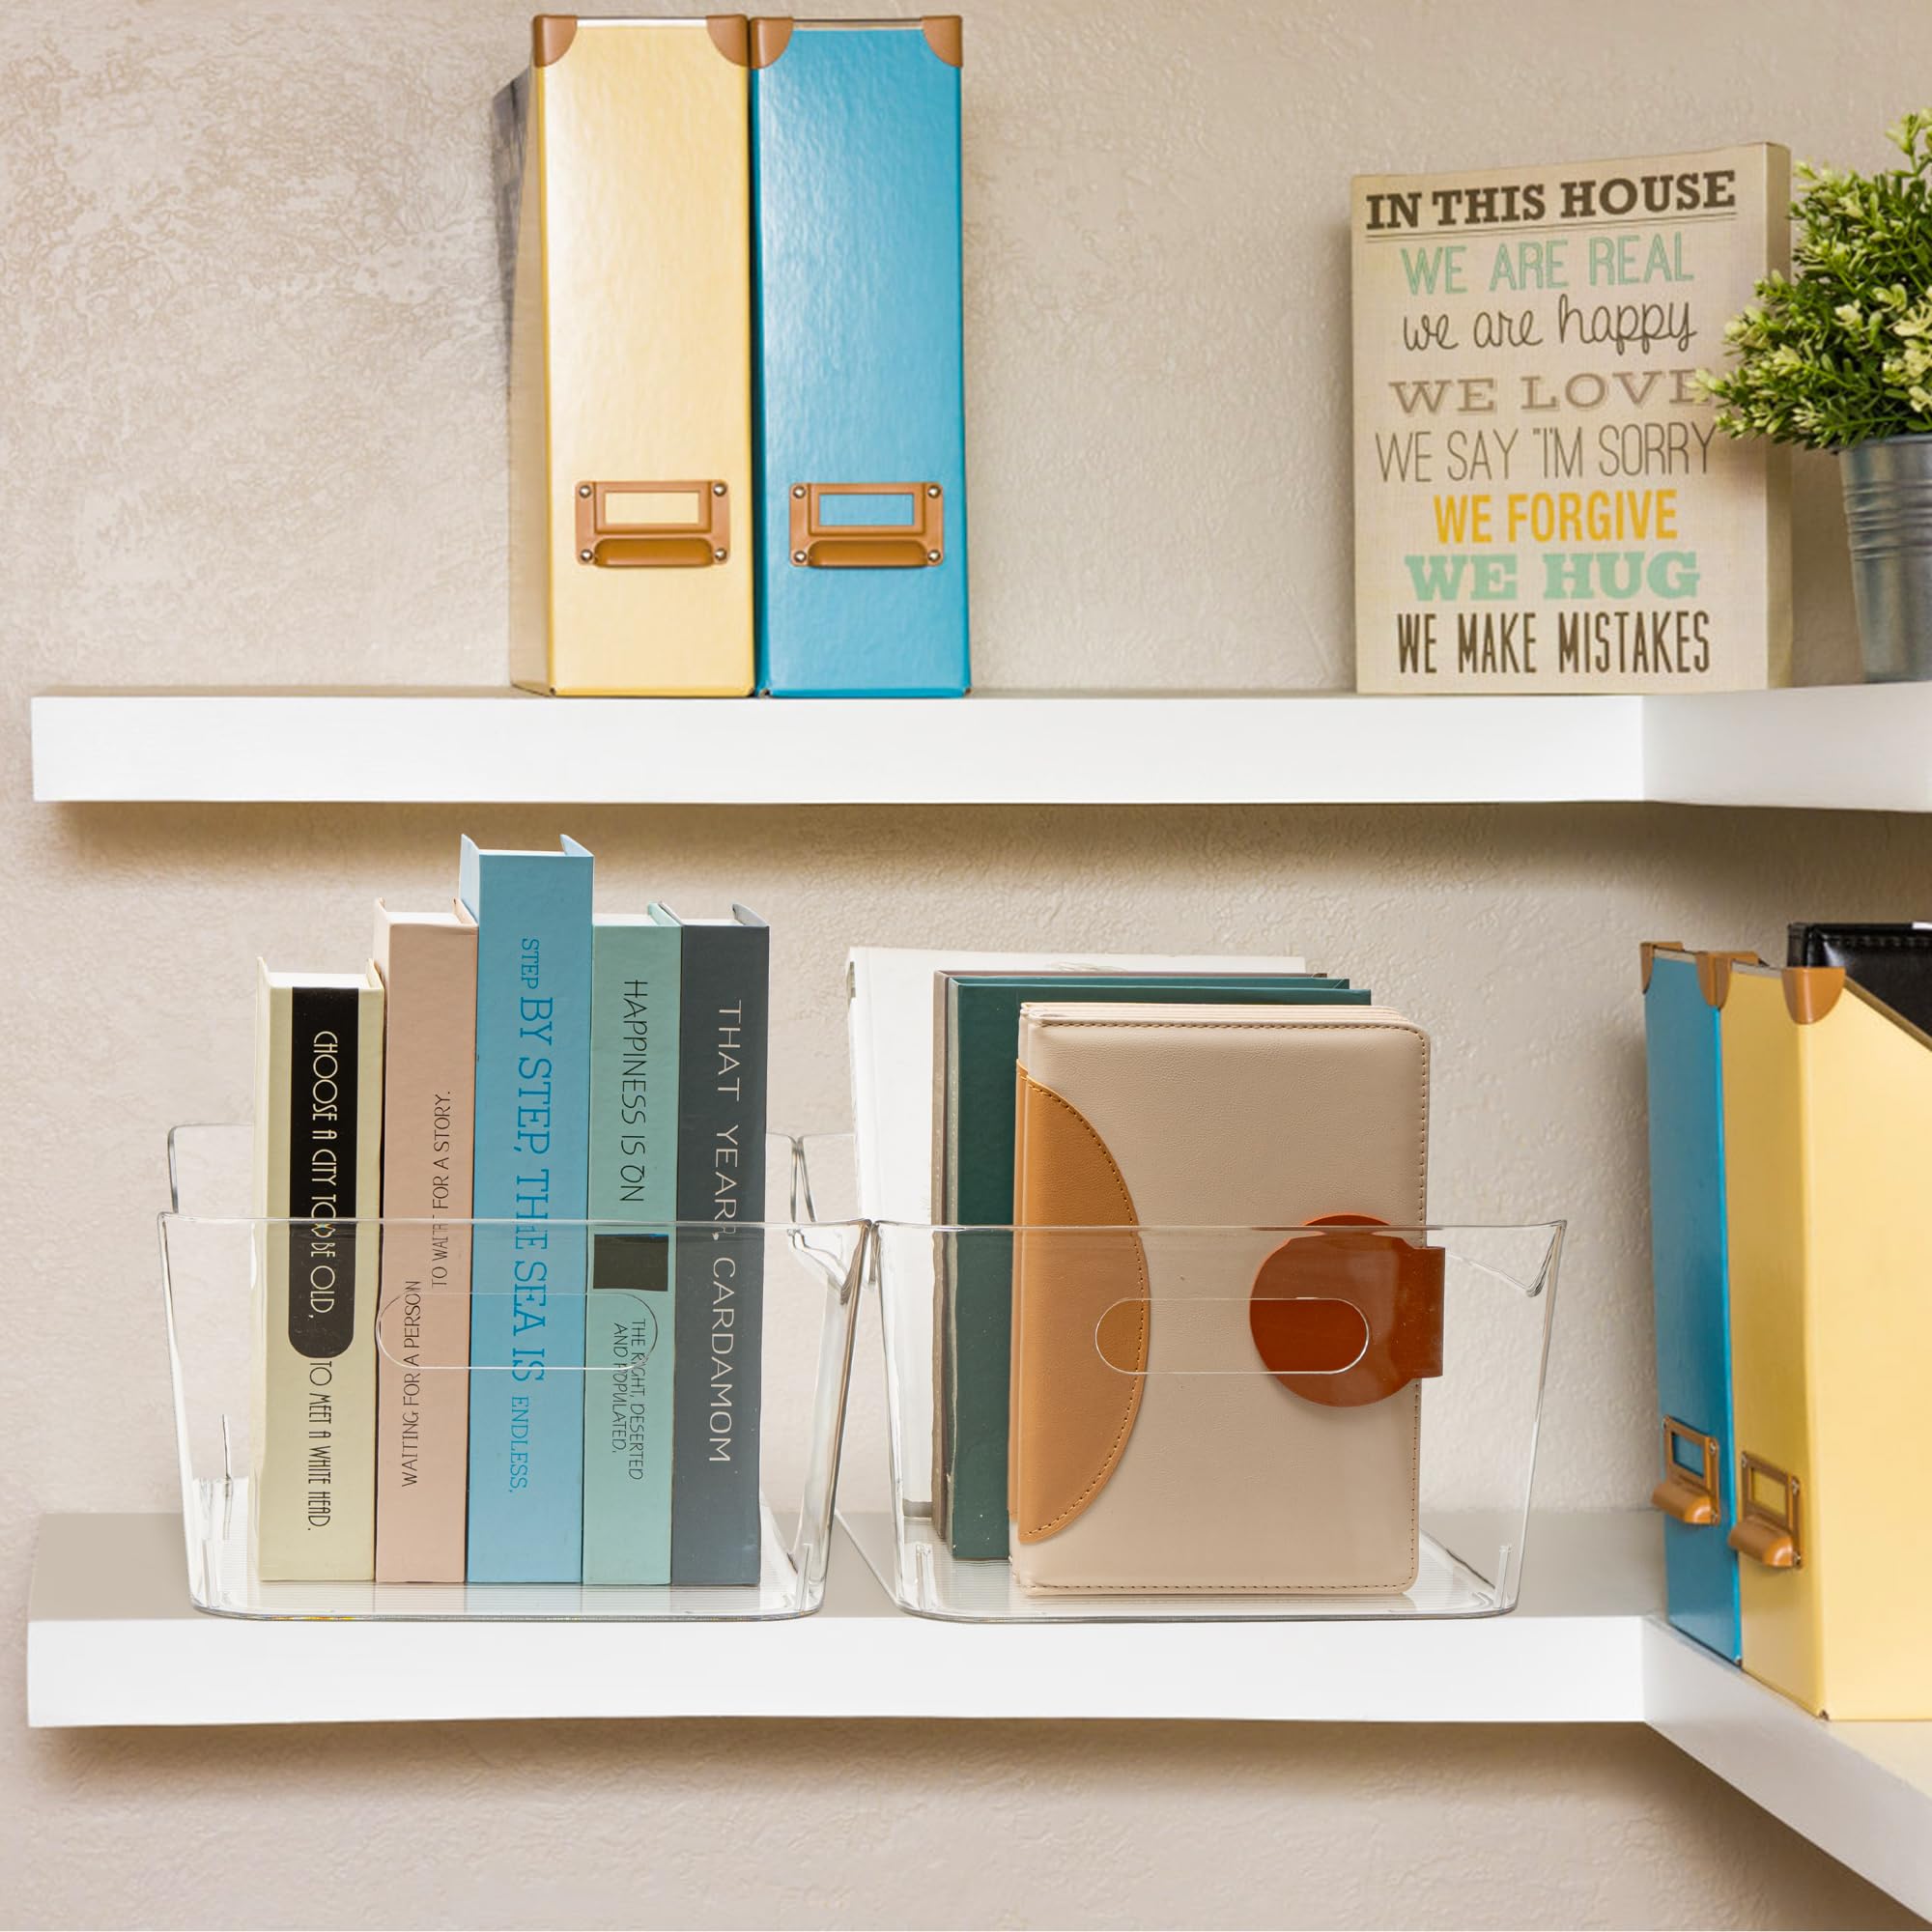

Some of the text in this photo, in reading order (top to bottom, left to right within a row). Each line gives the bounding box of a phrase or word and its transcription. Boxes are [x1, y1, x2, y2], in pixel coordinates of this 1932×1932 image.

[1366, 170, 1736, 230] IN THIS HOUSE
[1401, 232, 1694, 296] WE ARE REAL
[1403, 294, 1696, 355] we are happy
[1388, 369, 1717, 414] WE LOVE
[1375, 431, 1433, 482] WE
[1448, 428, 1519, 482] SAY
[1433, 489, 1678, 545] WE FORGIVE
[1404, 551, 1701, 601] WE HUG
[1397, 611, 1711, 673] WE MAKE MISTAKES
[312, 1031, 338, 1122] CHOOSE
[621, 980, 648, 1124] HAPPINESS
[718, 1000, 741, 1102] THAT
[312, 1129, 336, 1140] A
[434, 1092, 450, 1152] STORY.
[621, 1135, 645, 1155] IS
[311, 1149, 336, 1186] CITY
[434, 1157, 449, 1170] A
[433, 1176, 449, 1208] FOR
[508, 938, 554, 1492] STEP BY STEP, THE SEA IS ENDLESS,
[310, 1242, 335, 1258] BE
[432, 1266, 447, 1288] TO
[308, 1265, 335, 1321] OLD,
[310, 1361, 332, 1386] TO
[402, 1281, 421, 1487] WAITING FOR A PERSON
[611, 1322, 627, 1453] AND POPULATED.
[708, 1256, 736, 1463] CARDAMOM
[309, 1393, 331, 1424] MEET
[628, 1319, 645, 1480] THE RIGHT, DESERTED
[308, 1446, 330, 1485] WHITE
[307, 1492, 330, 1530] HEAD.
